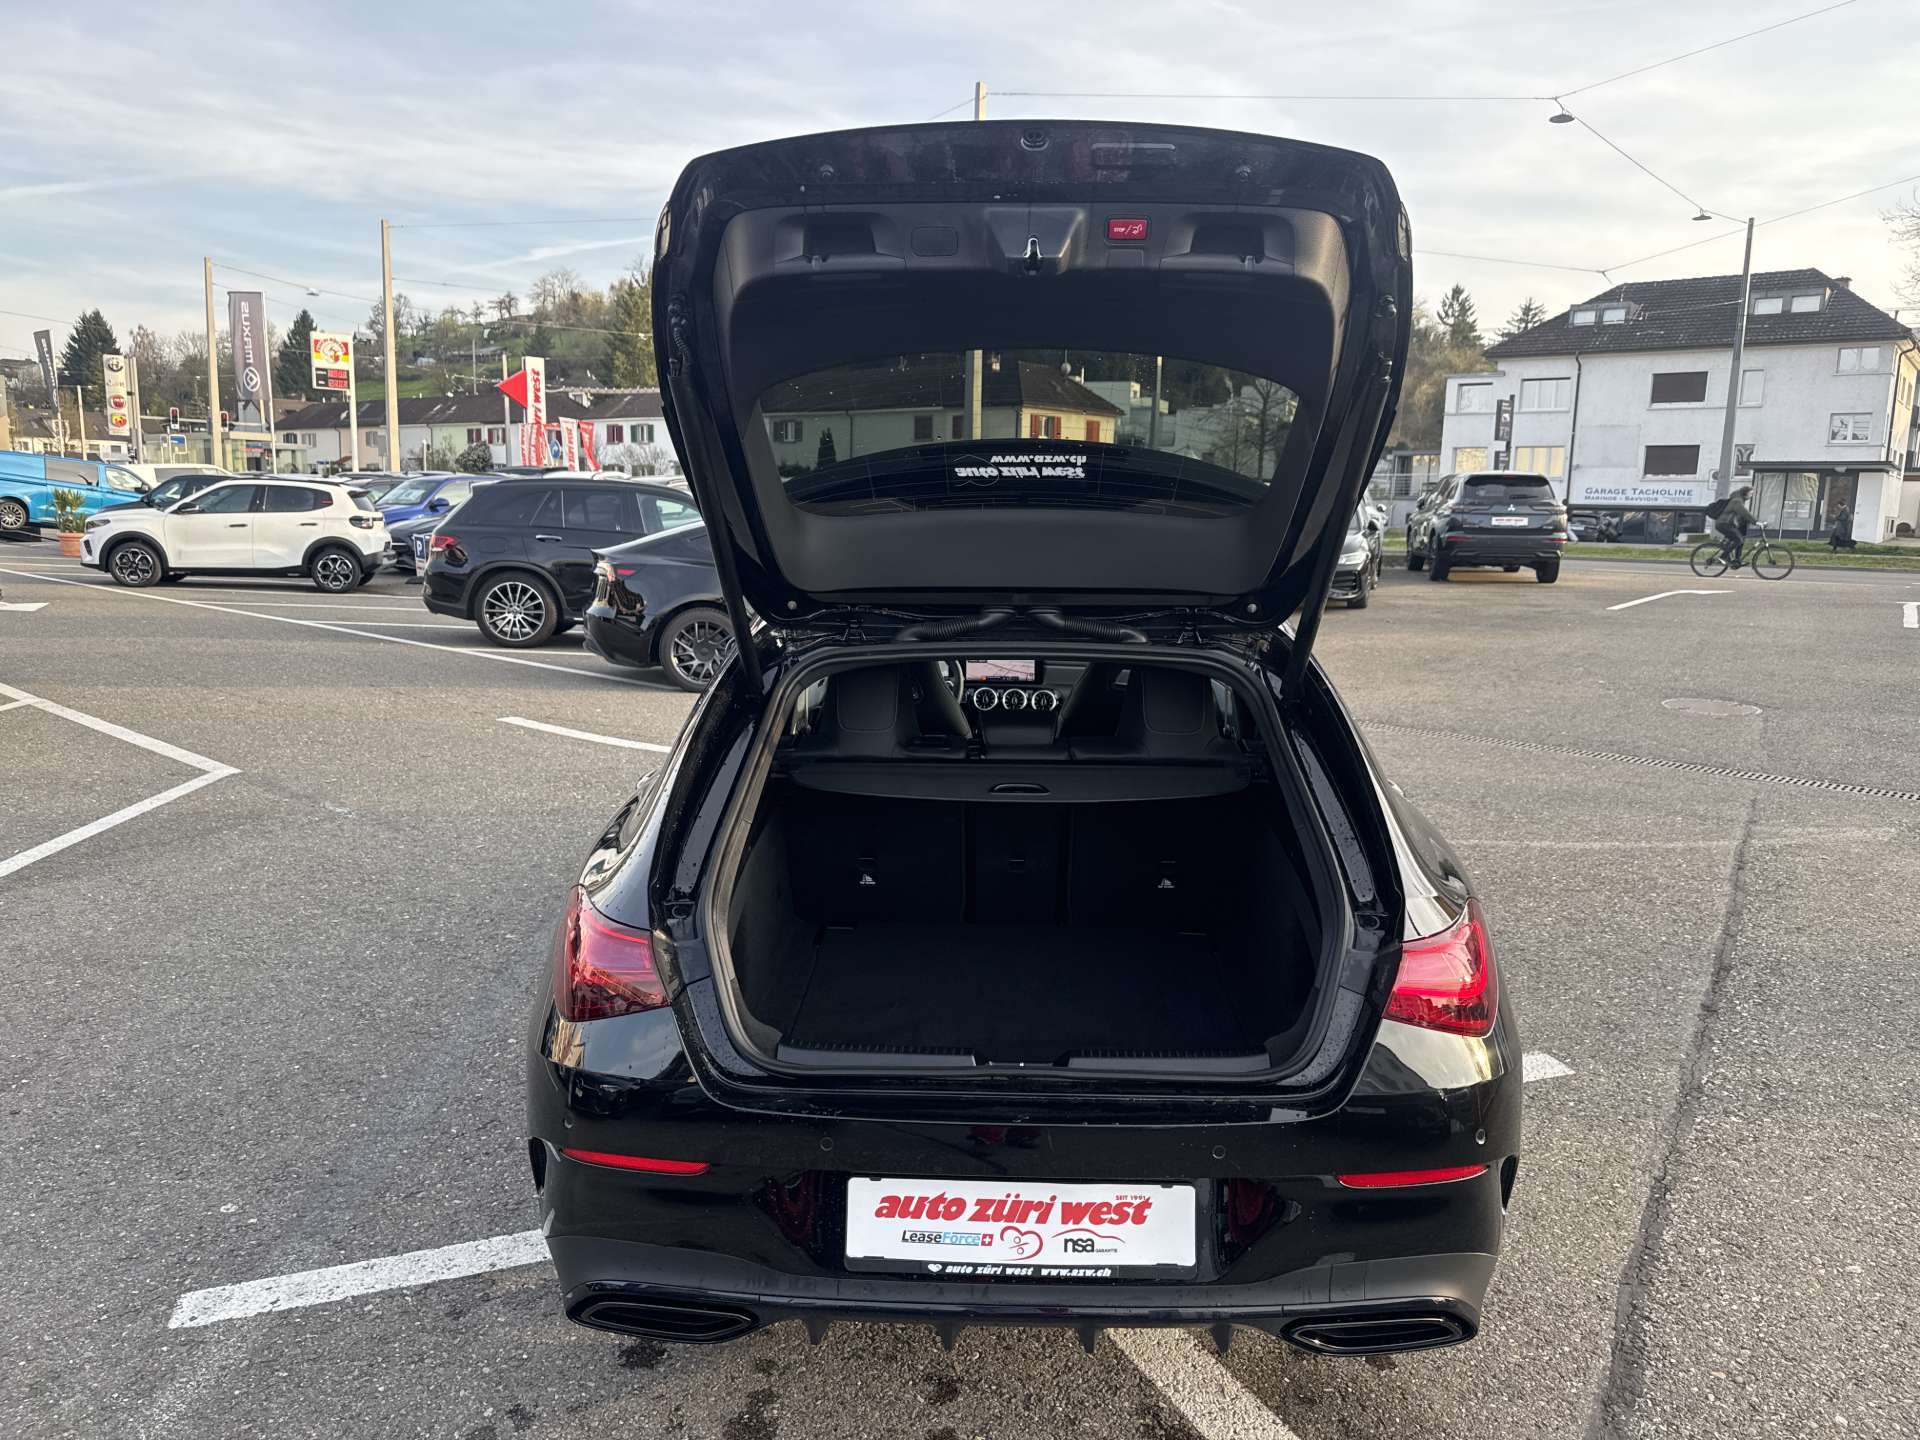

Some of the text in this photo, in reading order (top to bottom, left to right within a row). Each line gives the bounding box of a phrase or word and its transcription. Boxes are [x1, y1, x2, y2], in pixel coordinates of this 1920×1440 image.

[532, 368, 542, 404] west
[1584, 487, 1693, 497] GARAGE TACHOLINE
[416, 540, 422, 556] P
[874, 1191, 1153, 1226] auto züri west
[901, 1230, 981, 1246] LeaseForce
[1063, 1238, 1095, 1253] nsa
[945, 1264, 1112, 1278] auto züri west www.azw.ch
